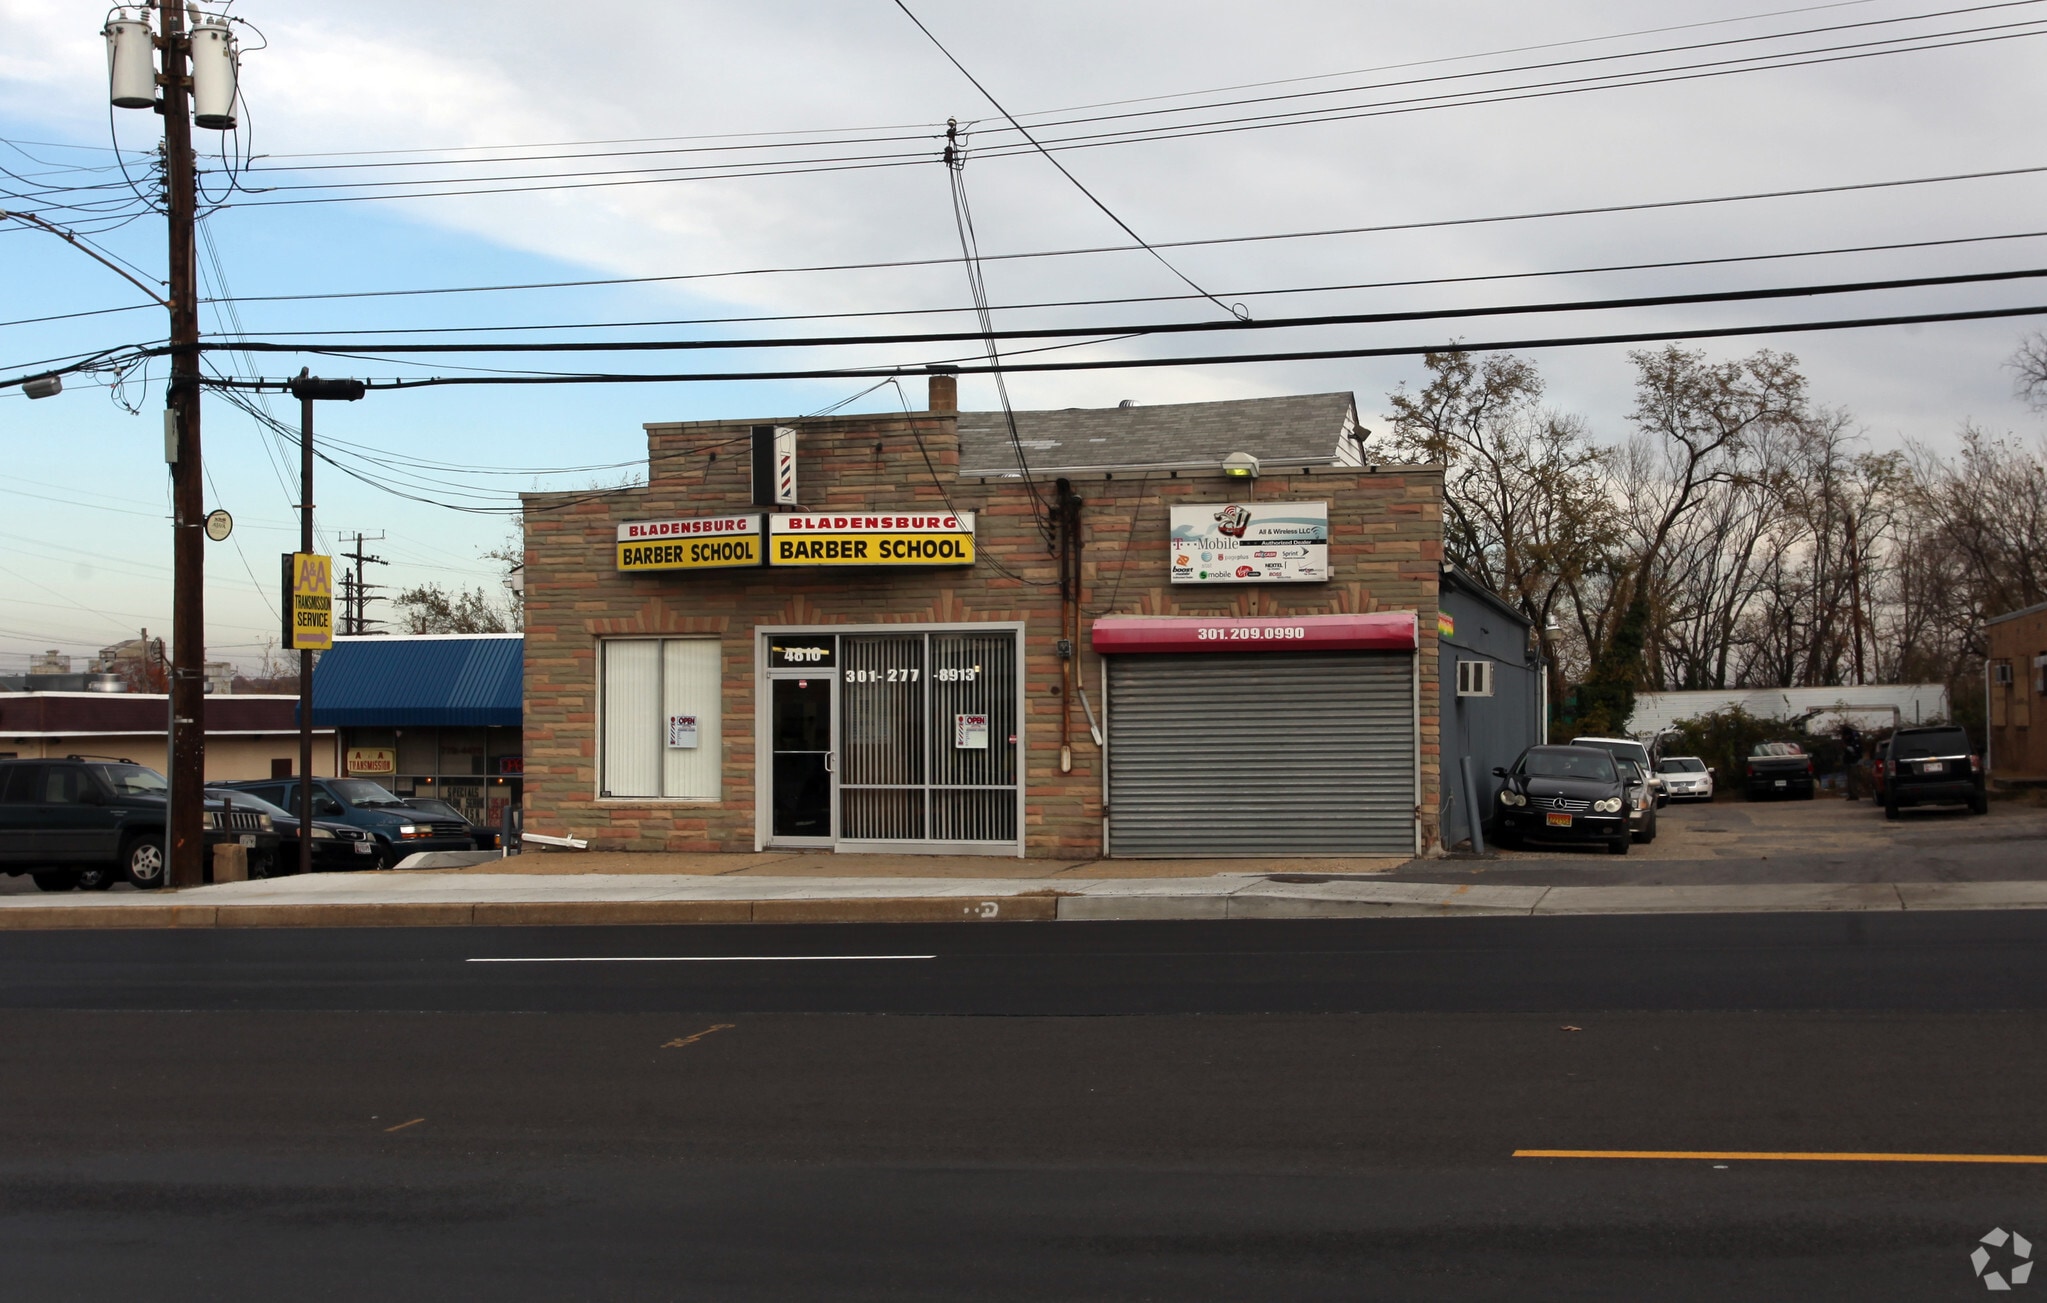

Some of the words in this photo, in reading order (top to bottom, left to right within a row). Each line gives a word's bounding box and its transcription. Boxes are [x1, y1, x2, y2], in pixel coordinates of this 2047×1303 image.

[629, 518, 747, 537] BLADENSBURG
[788, 517, 957, 530] BLADENSBURG
[779, 540, 868, 560] BARBER
[879, 539, 966, 559] SCHOOL
[1198, 537, 1239, 550] Mobile
[623, 543, 683, 566] BARBER
[691, 541, 753, 562] SCHOOL
[294, 560, 332, 593] A&A
[1208, 570, 1232, 578] mobile
[295, 594, 331, 611] TRANSMISSION
[297, 611, 328, 628] SERVICE
[1198, 627, 1305, 640] 301.209.0990
[678, 716, 695, 725] OPEN
[966, 716, 985, 725] OPEN
[349, 760, 391, 771] TRANSMISSION
[447, 786, 479, 798] SPECIALS
